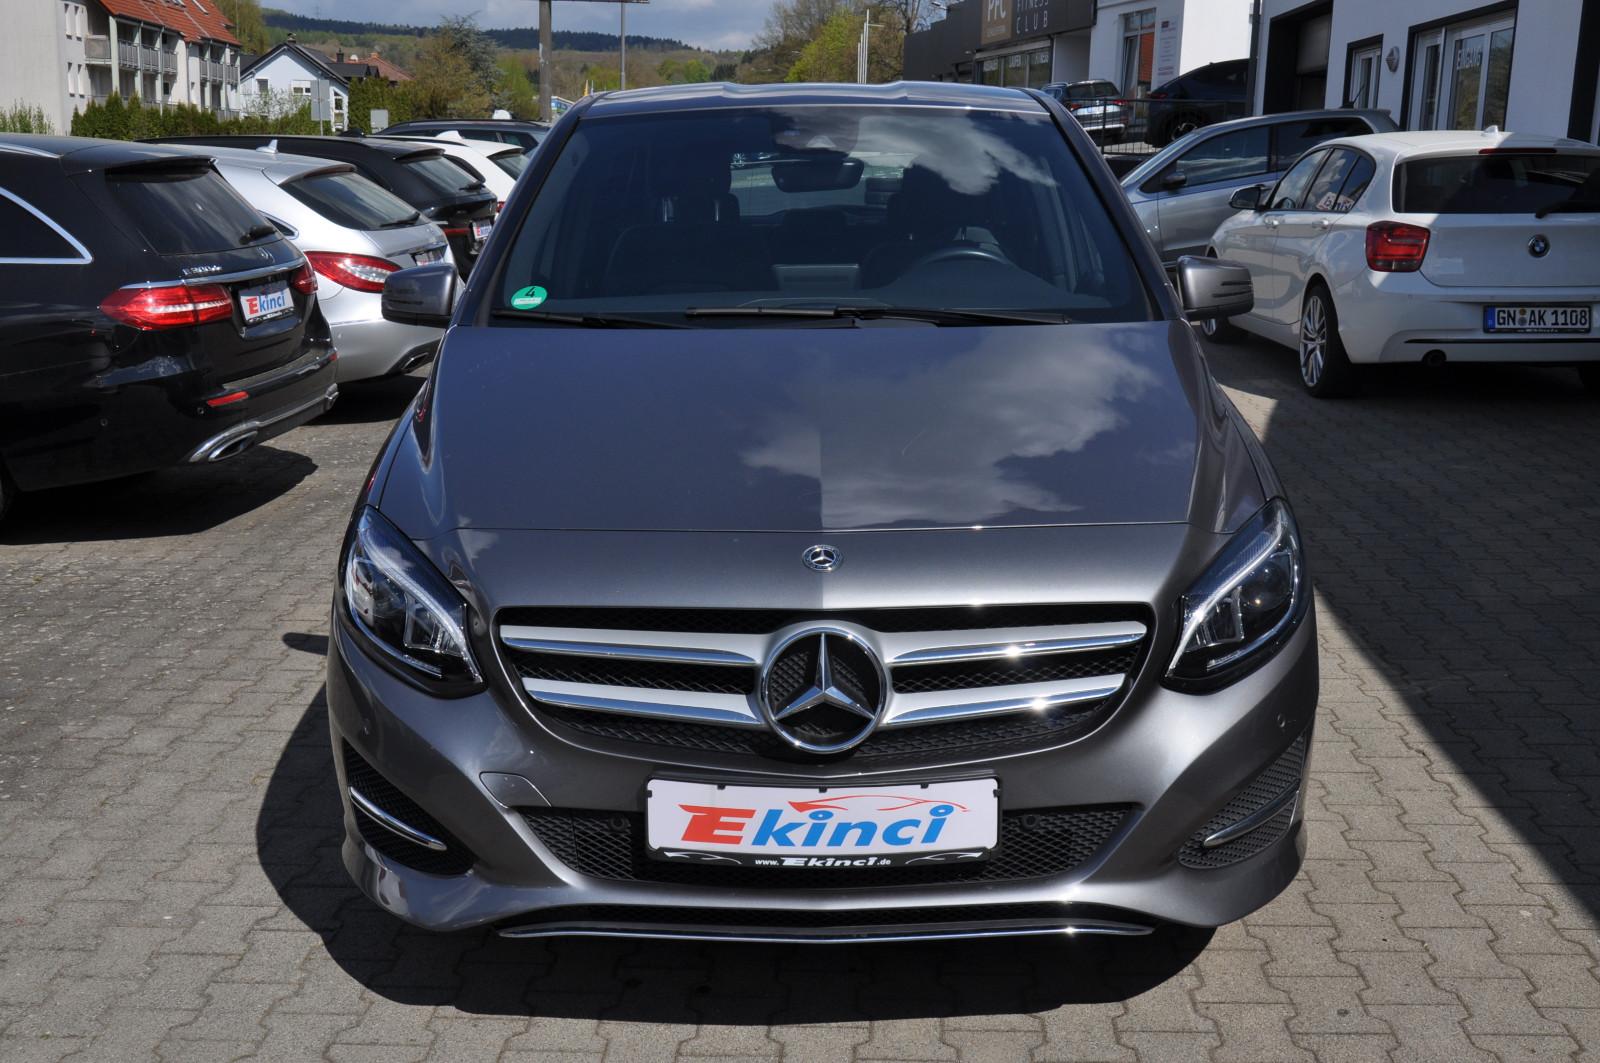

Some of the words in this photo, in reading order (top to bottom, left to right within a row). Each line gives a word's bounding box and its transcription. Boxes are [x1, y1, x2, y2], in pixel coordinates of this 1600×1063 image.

[1016, 10, 1049, 34] CLUB
[525, 286, 536, 298] 4
[246, 292, 286, 315] Ekinci
[1496, 309, 1517, 326] GN
[1528, 309, 1547, 326] AK
[1551, 309, 1588, 326] 1108
[678, 803, 955, 848] Ekinci
[755, 857, 891, 867] www.Ekinci.de
